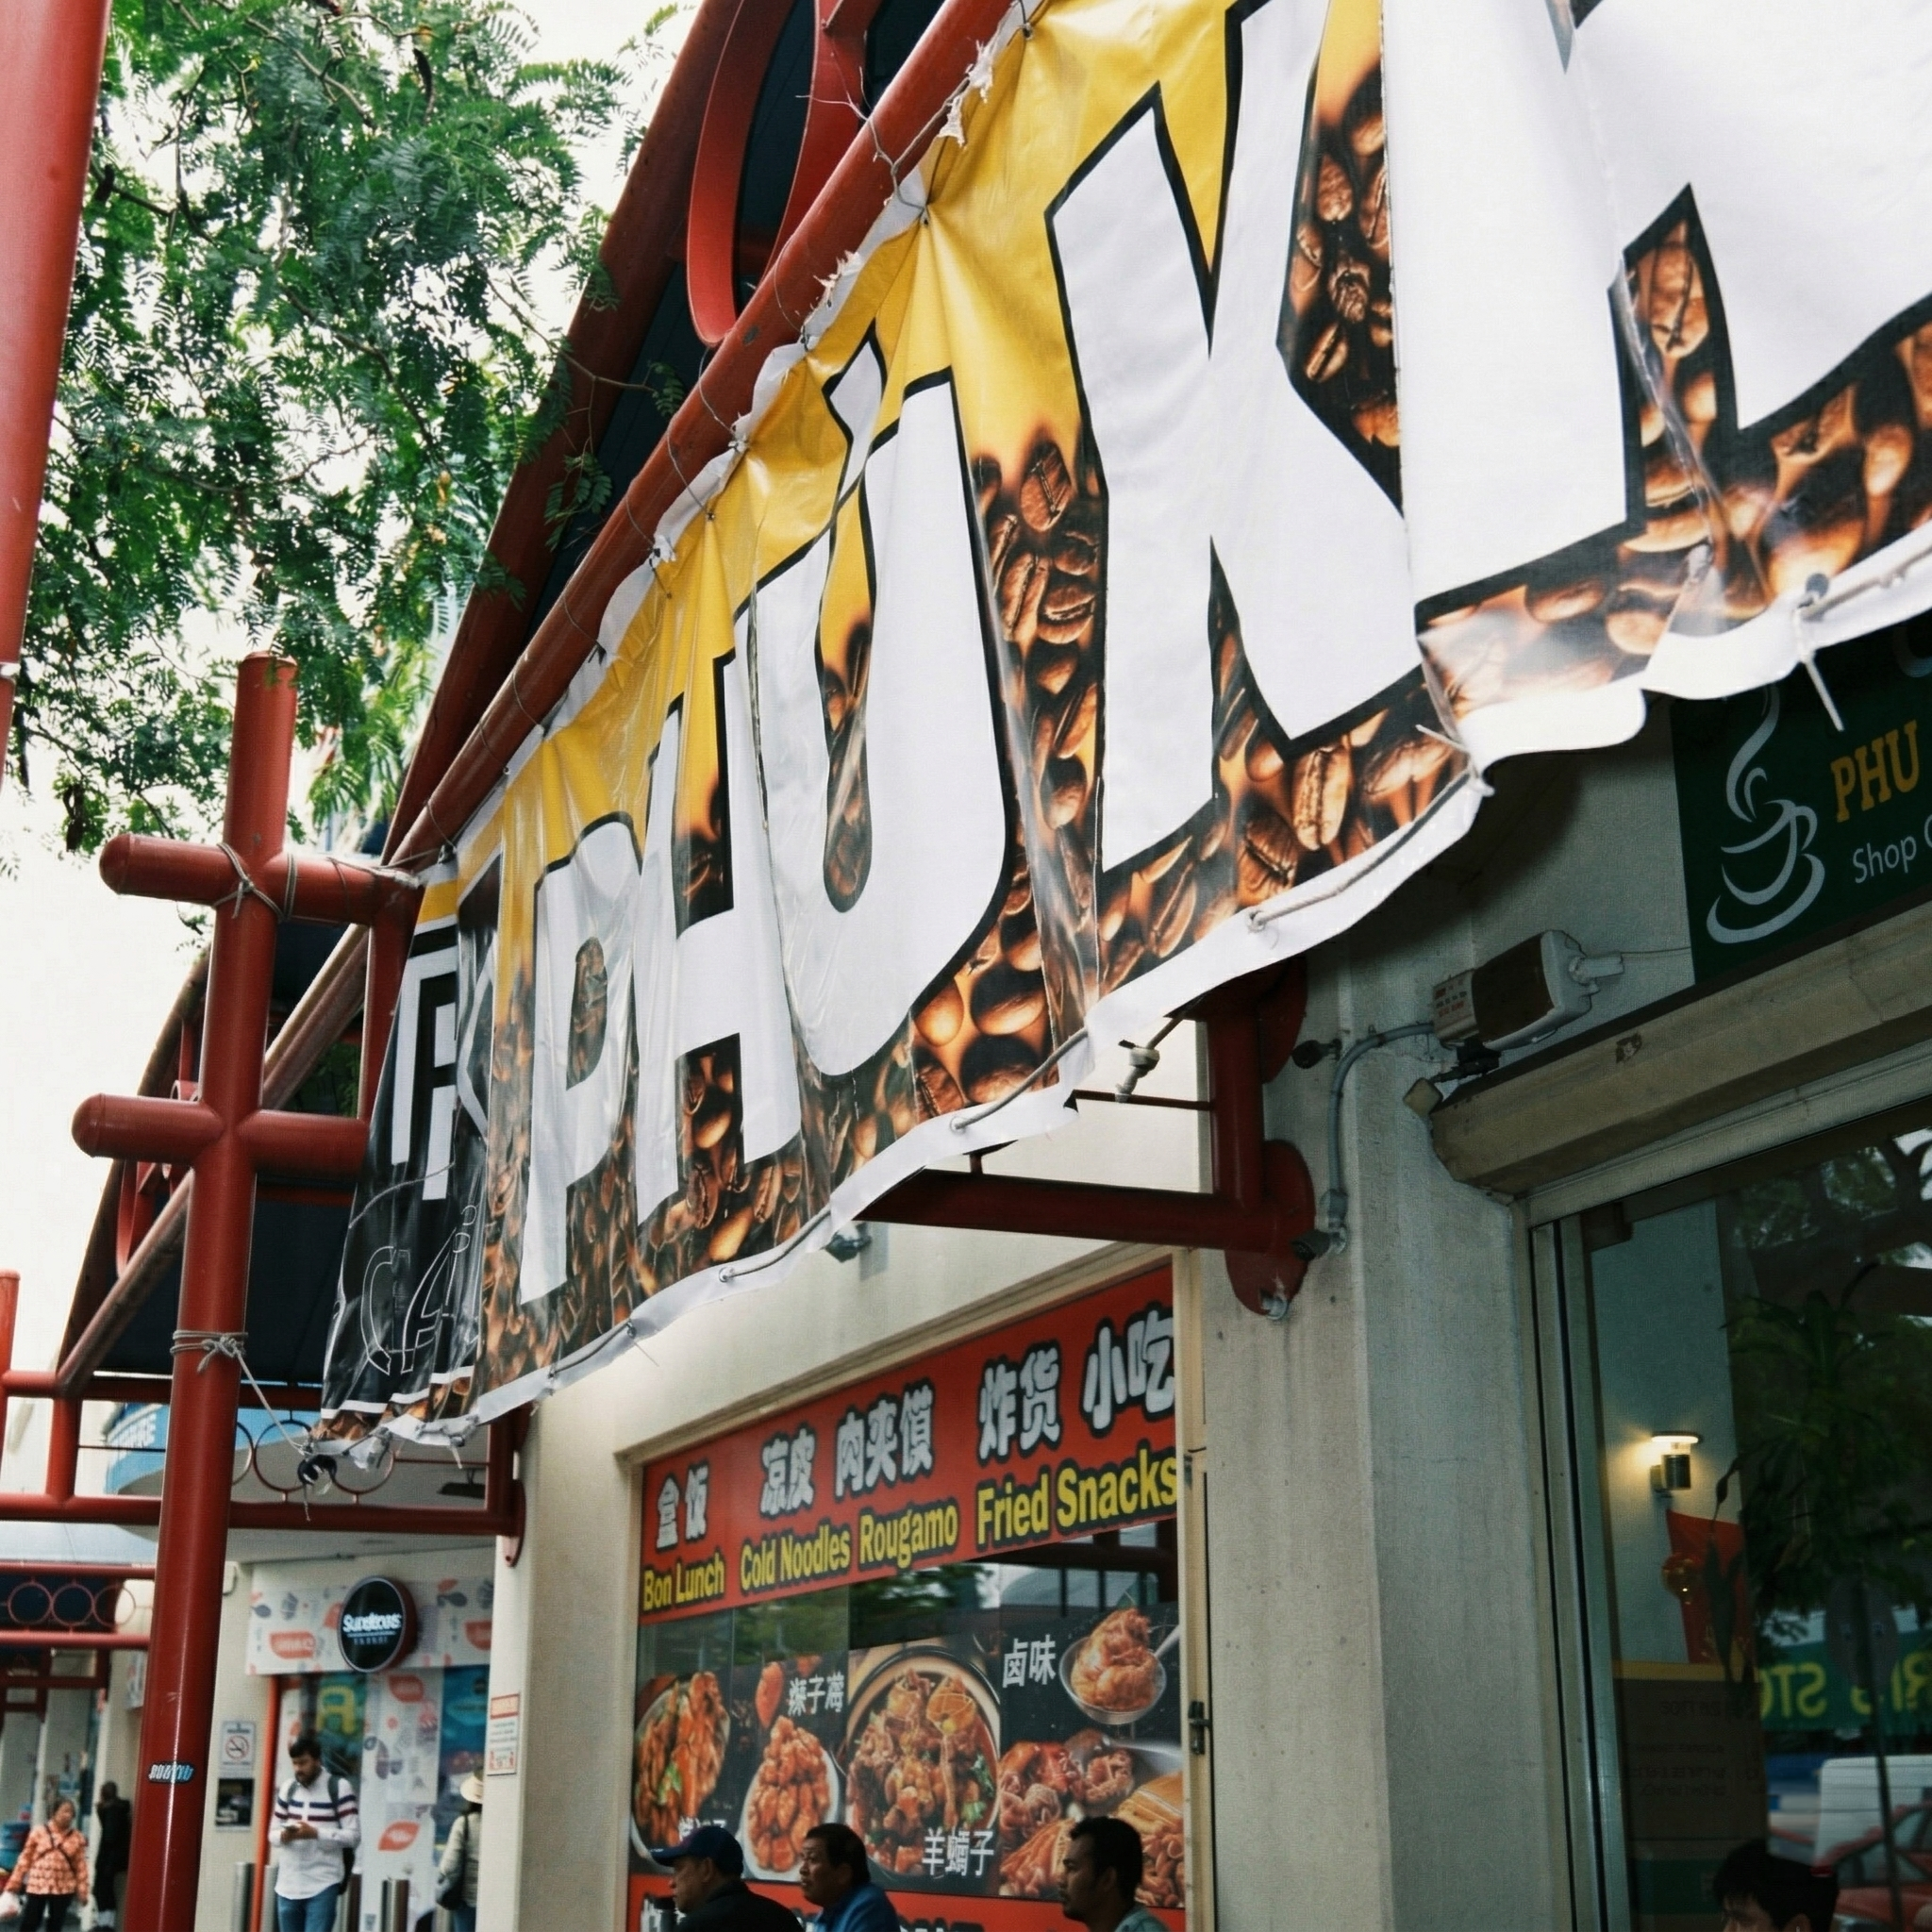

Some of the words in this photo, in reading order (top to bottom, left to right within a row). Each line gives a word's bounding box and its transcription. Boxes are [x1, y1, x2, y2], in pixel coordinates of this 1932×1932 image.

[1830, 720, 1921, 823] PHU
[1853, 836, 1917, 883] Shop
[1083, 1309, 1175, 1429] 小吃
[675, 1552, 724, 1604] Lunch
[740, 1538, 776, 1591] Cold
[780, 1523, 851, 1582] Noodles
[859, 1505, 958, 1569] Rougamo
[977, 1473, 1050, 1545] Fried
[1057, 1448, 1177, 1528] Snacks
[1002, 1633, 1057, 1689] 卤味
